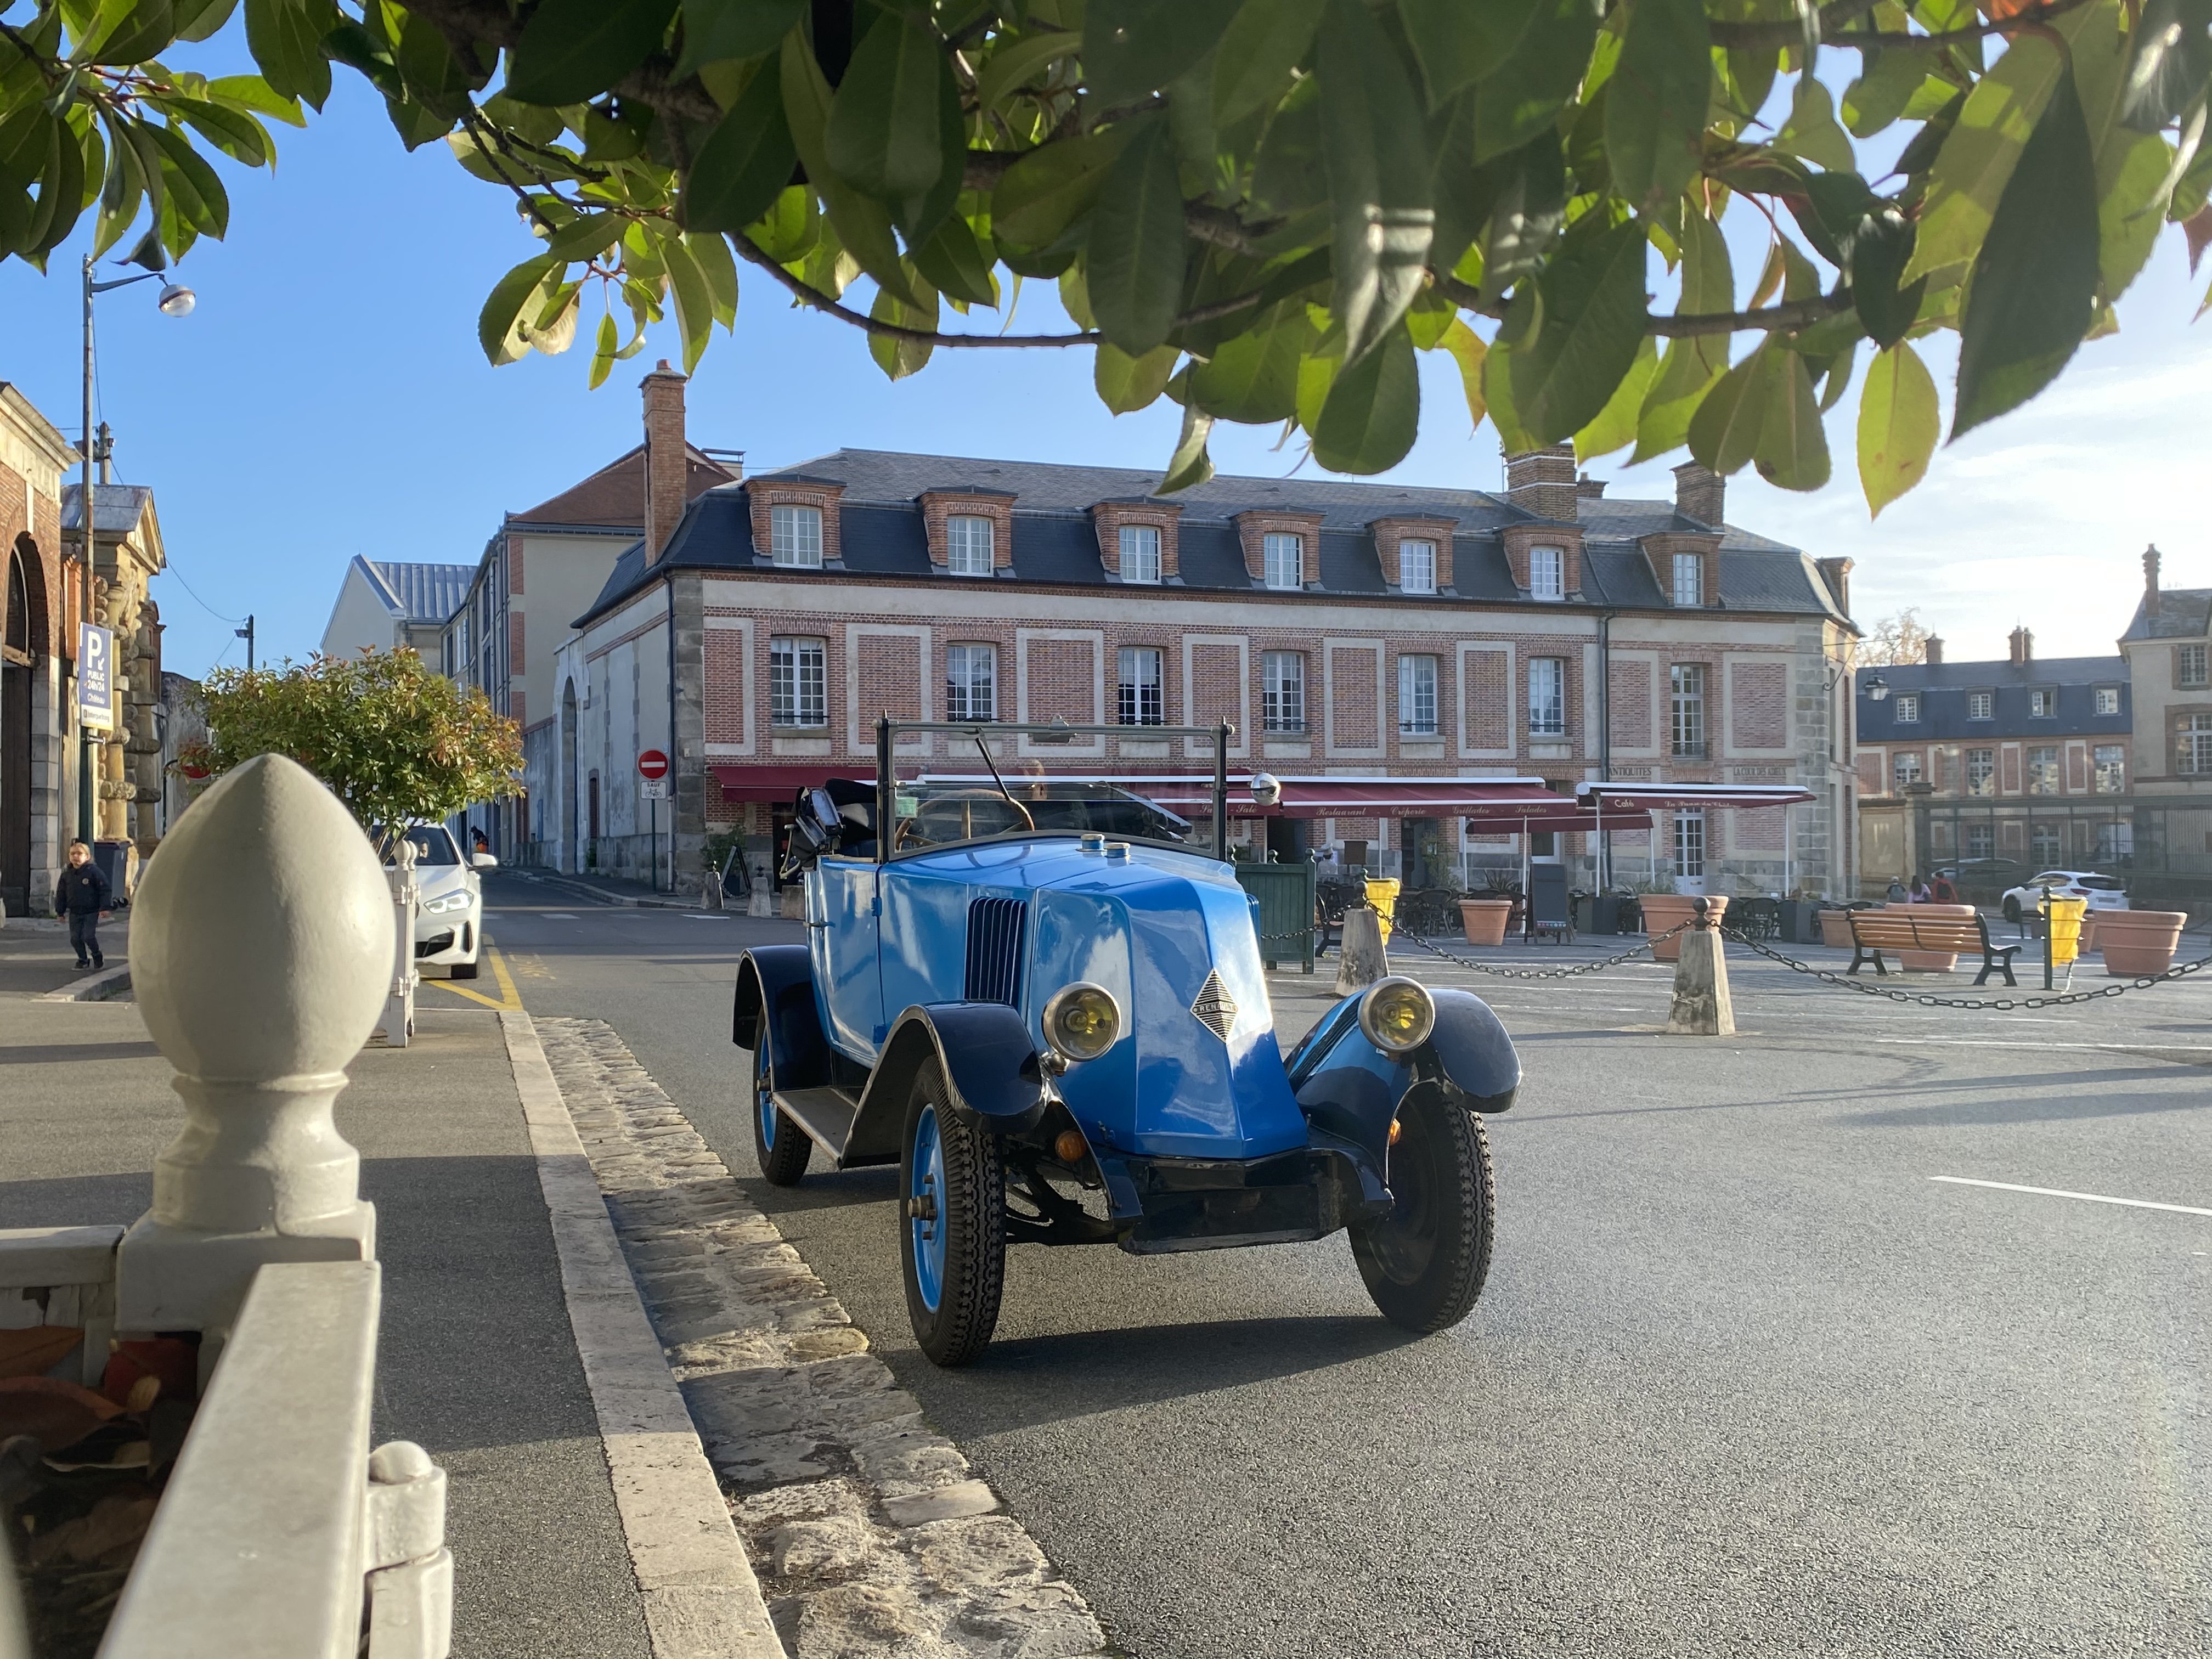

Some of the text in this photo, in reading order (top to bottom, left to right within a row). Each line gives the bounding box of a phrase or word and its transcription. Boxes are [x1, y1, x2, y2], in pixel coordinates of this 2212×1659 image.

[88, 631, 102, 668] P
[88, 670, 105, 681] PUBLIC
[1615, 799, 1635, 808] Café
[1316, 804, 1547, 817] Restaurant Crêperie Grillades Salades
